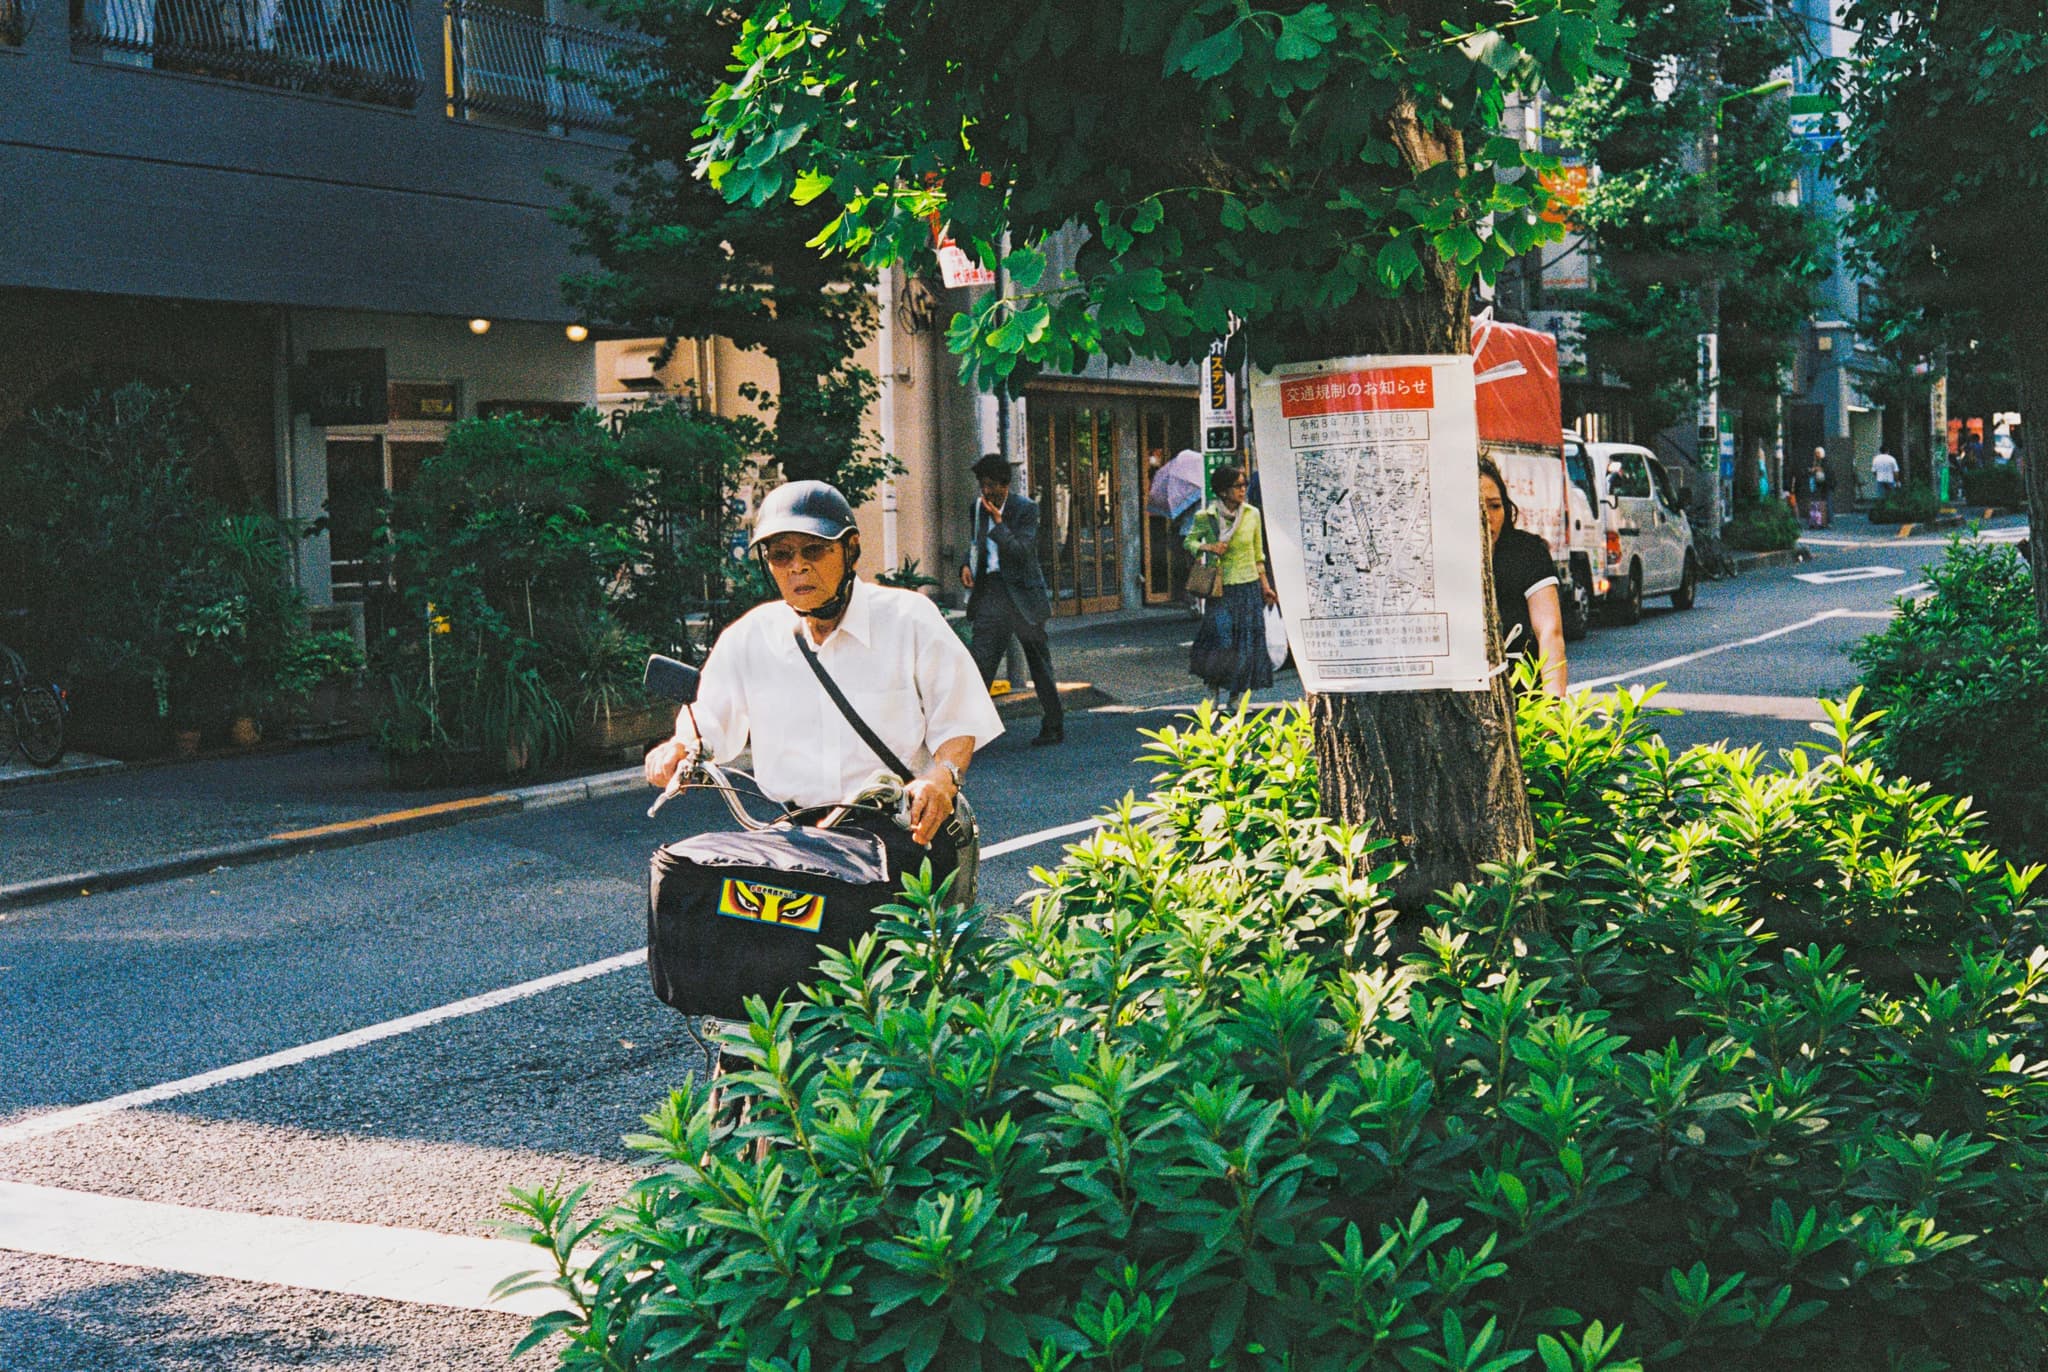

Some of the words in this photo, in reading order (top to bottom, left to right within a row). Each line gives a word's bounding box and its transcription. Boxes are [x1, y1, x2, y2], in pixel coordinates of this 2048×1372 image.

[1211, 356, 1225, 408] ステップ
[1286, 379, 1428, 402] 交通規制のお知らせ
